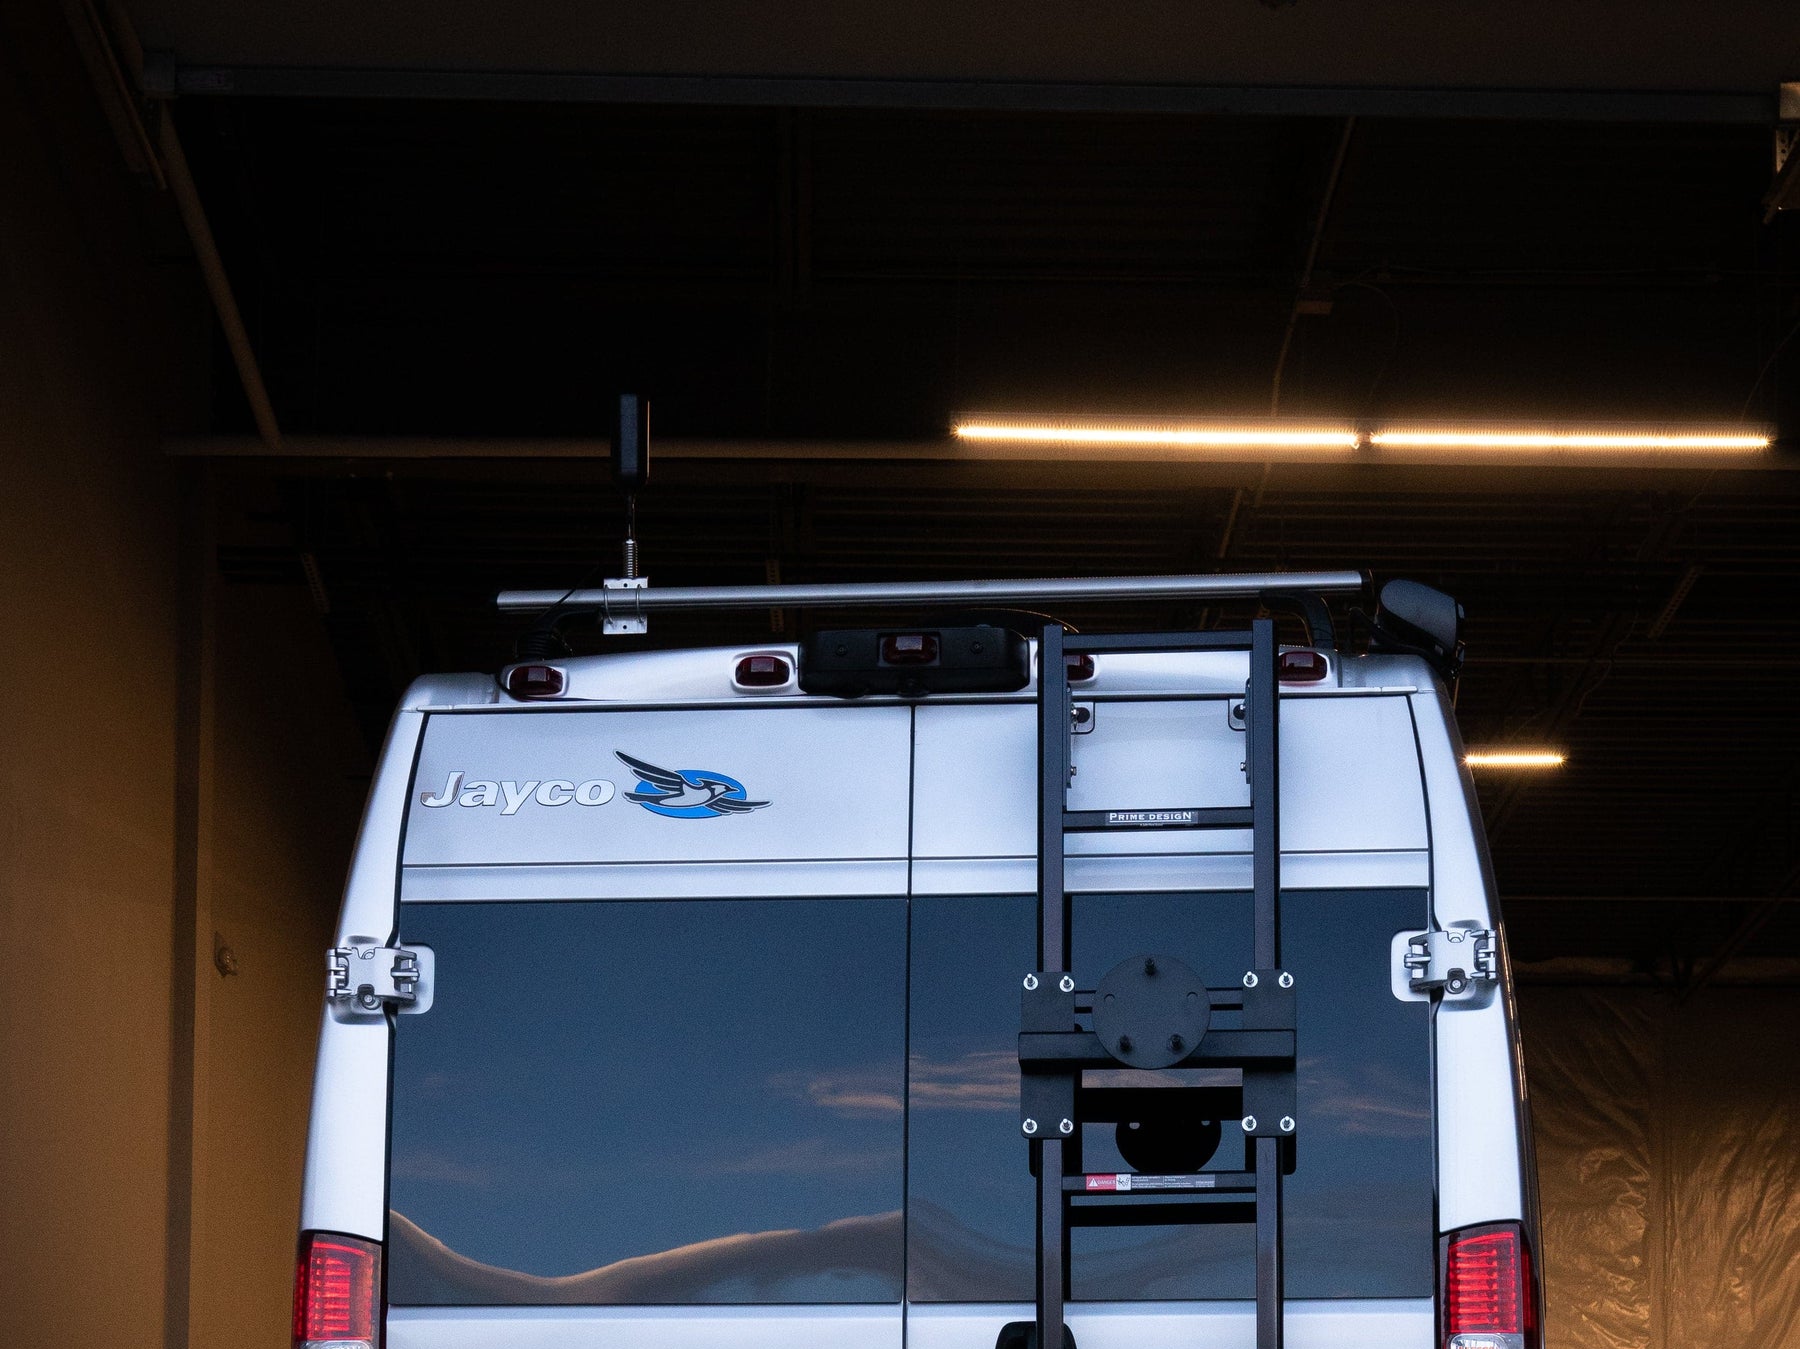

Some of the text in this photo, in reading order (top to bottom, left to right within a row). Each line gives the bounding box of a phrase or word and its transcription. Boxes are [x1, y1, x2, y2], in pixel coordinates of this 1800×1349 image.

[420, 770, 616, 816] Jayco
[1109, 811, 1192, 821] PRIME DESIGN
